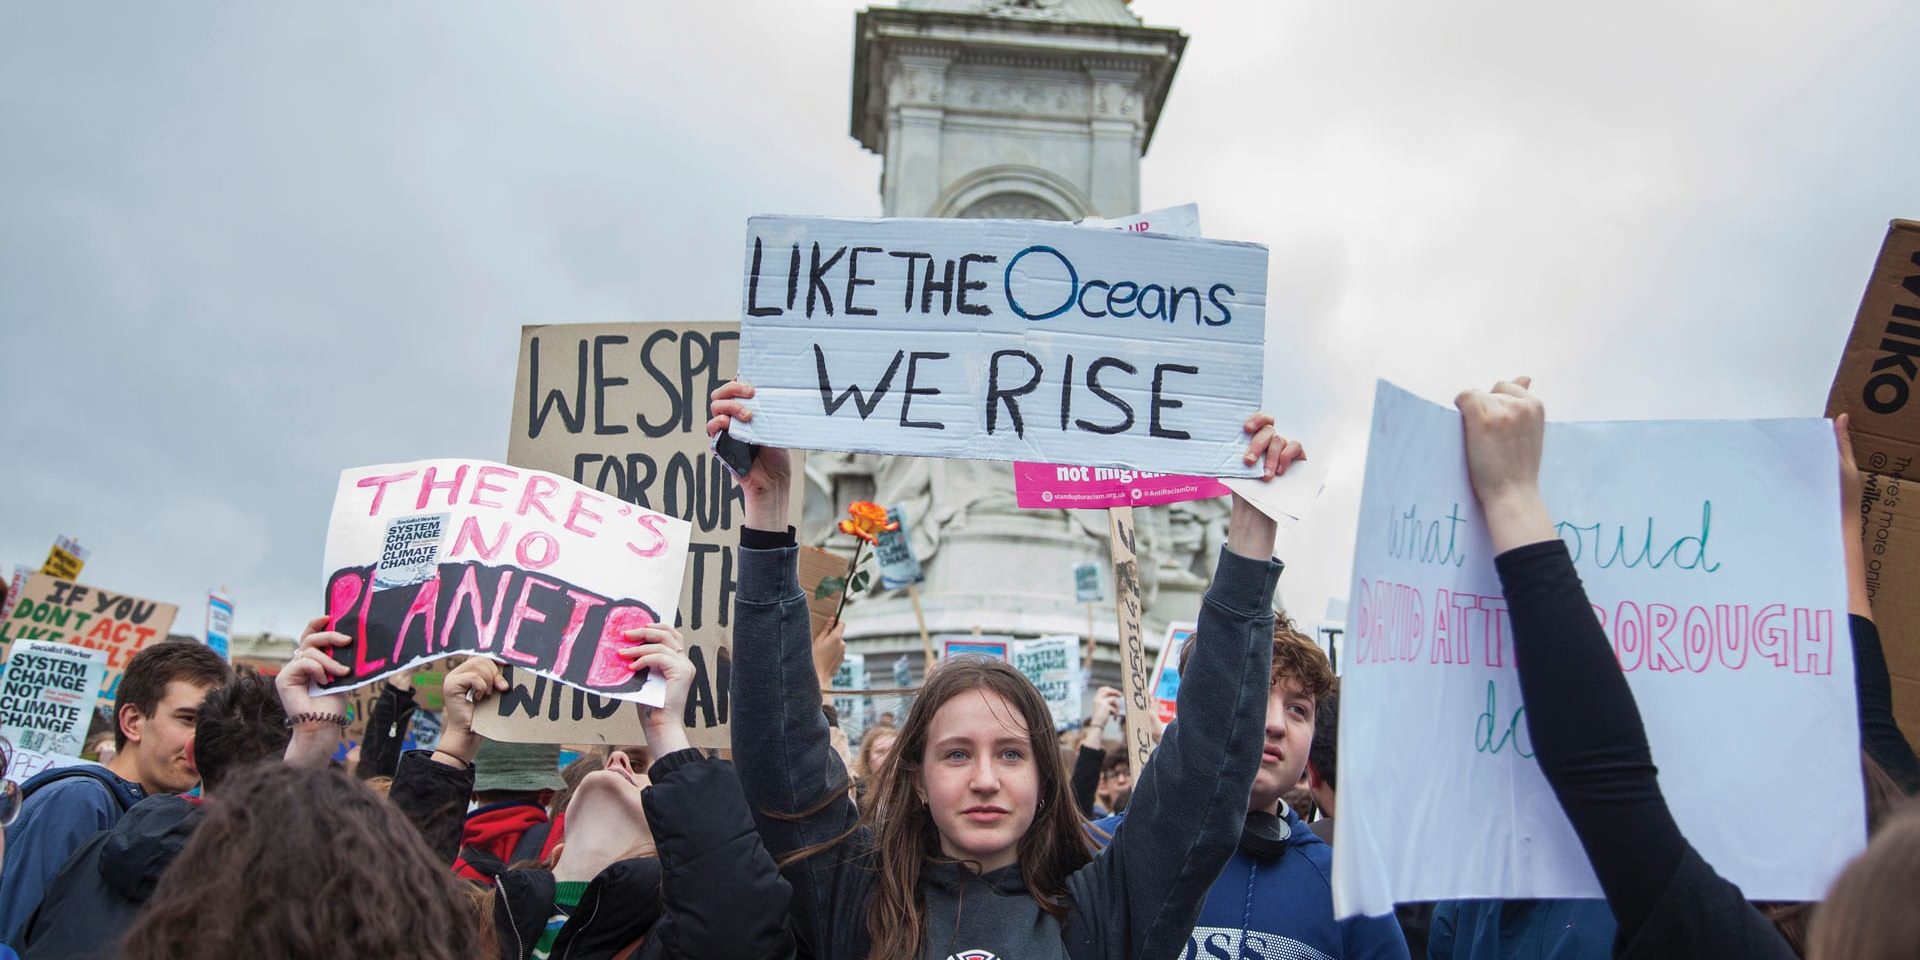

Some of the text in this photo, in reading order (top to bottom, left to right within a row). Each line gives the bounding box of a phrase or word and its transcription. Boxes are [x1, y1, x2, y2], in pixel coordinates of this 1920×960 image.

[748, 236, 1235, 326] LIKE THE Oceans
[528, 335, 629, 439] WE
[813, 343, 1199, 440] WE RISE
[1056, 466, 1090, 482] not
[1054, 485, 1198, 502] standuptoracism.org.uk @AntiRacismDay
[358, 465, 667, 557] THERE'S
[386, 529, 441, 543] CHANGE
[388, 521, 441, 535] SYSTEM
[1553, 500, 1720, 573] ould
[1865, 457, 1912, 608] There's more onlin
[382, 545, 438, 561] CLIMATE
[384, 541, 411, 552] NOT
[450, 515, 560, 570] NO
[380, 554, 434, 570] CHANGE
[46, 581, 89, 606] IF
[94, 591, 157, 624] YOU
[87, 618, 156, 648] ACT
[328, 565, 658, 687] PLANET B
[1430, 588, 1832, 675] ATTOROUGH
[30, 643, 64, 654] Socialist
[64, 648, 92, 659] Worker
[11, 653, 87, 677] SYSTEM
[3, 682, 43, 699] NOT
[8, 667, 87, 692] CHANGE
[0, 696, 81, 721] CLIMATE
[0, 710, 75, 733] CHANGE
